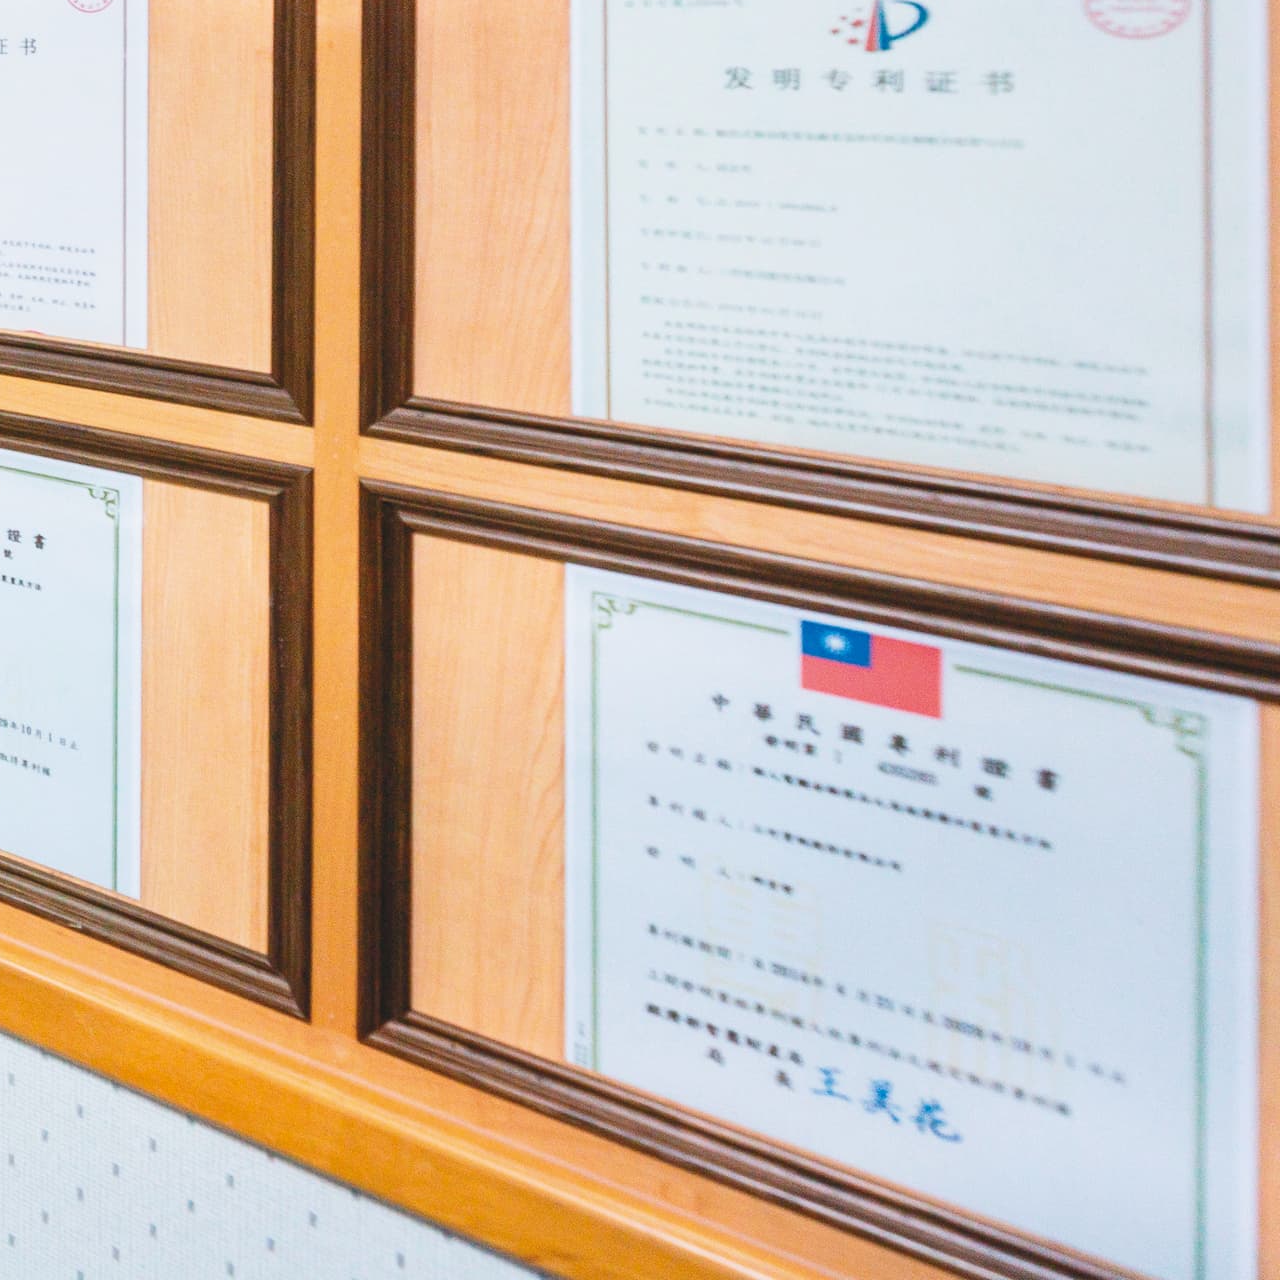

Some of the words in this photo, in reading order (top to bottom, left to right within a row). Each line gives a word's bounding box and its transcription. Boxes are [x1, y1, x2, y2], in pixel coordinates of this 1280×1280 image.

[722, 64, 1017, 96] 发明专利证书
[711, 692, 1058, 792] 中華民國專利證書
[811, 1065, 963, 1143] 王美花
